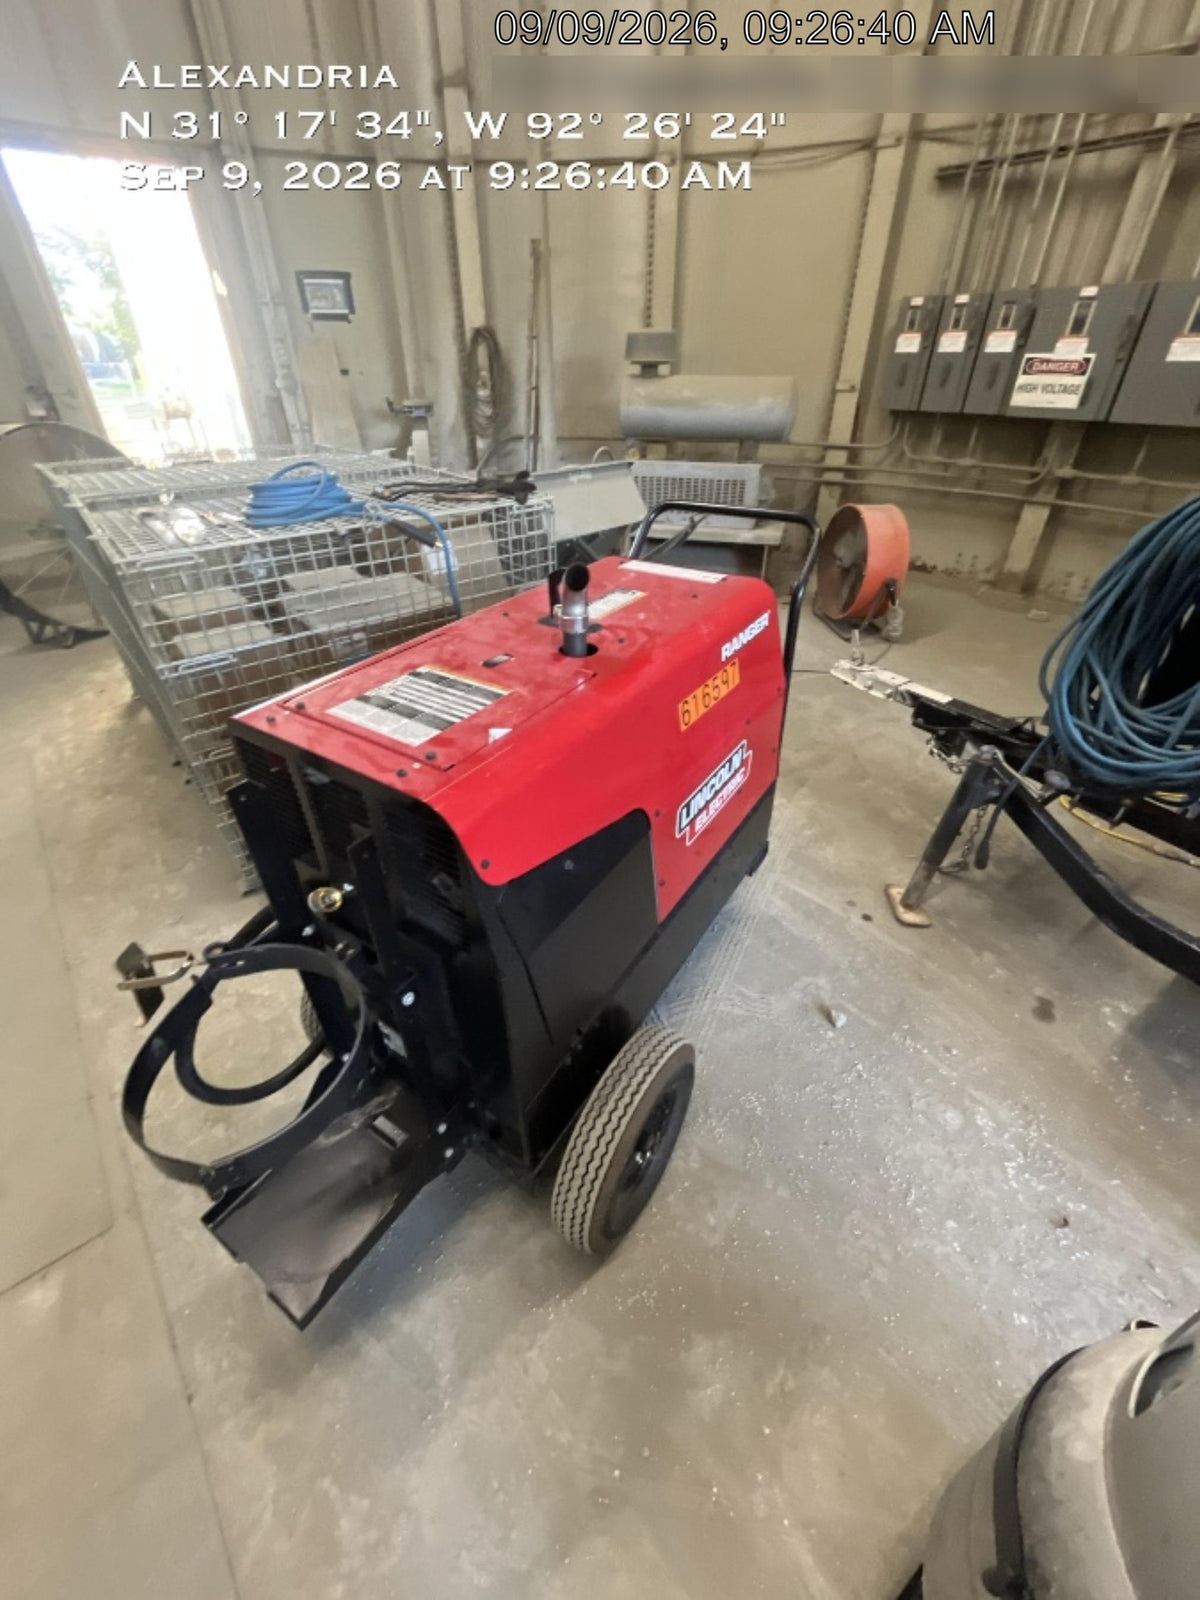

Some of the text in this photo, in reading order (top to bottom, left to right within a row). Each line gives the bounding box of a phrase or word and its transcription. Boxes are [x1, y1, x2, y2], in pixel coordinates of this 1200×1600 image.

[1017, 383, 1083, 396] HIGH VOLTAGE
[1031, 361, 1080, 372] DANGER
[721, 611, 770, 662] RANGER
[681, 660, 737, 727] 616597
[680, 746, 744, 830] LINCOLN
